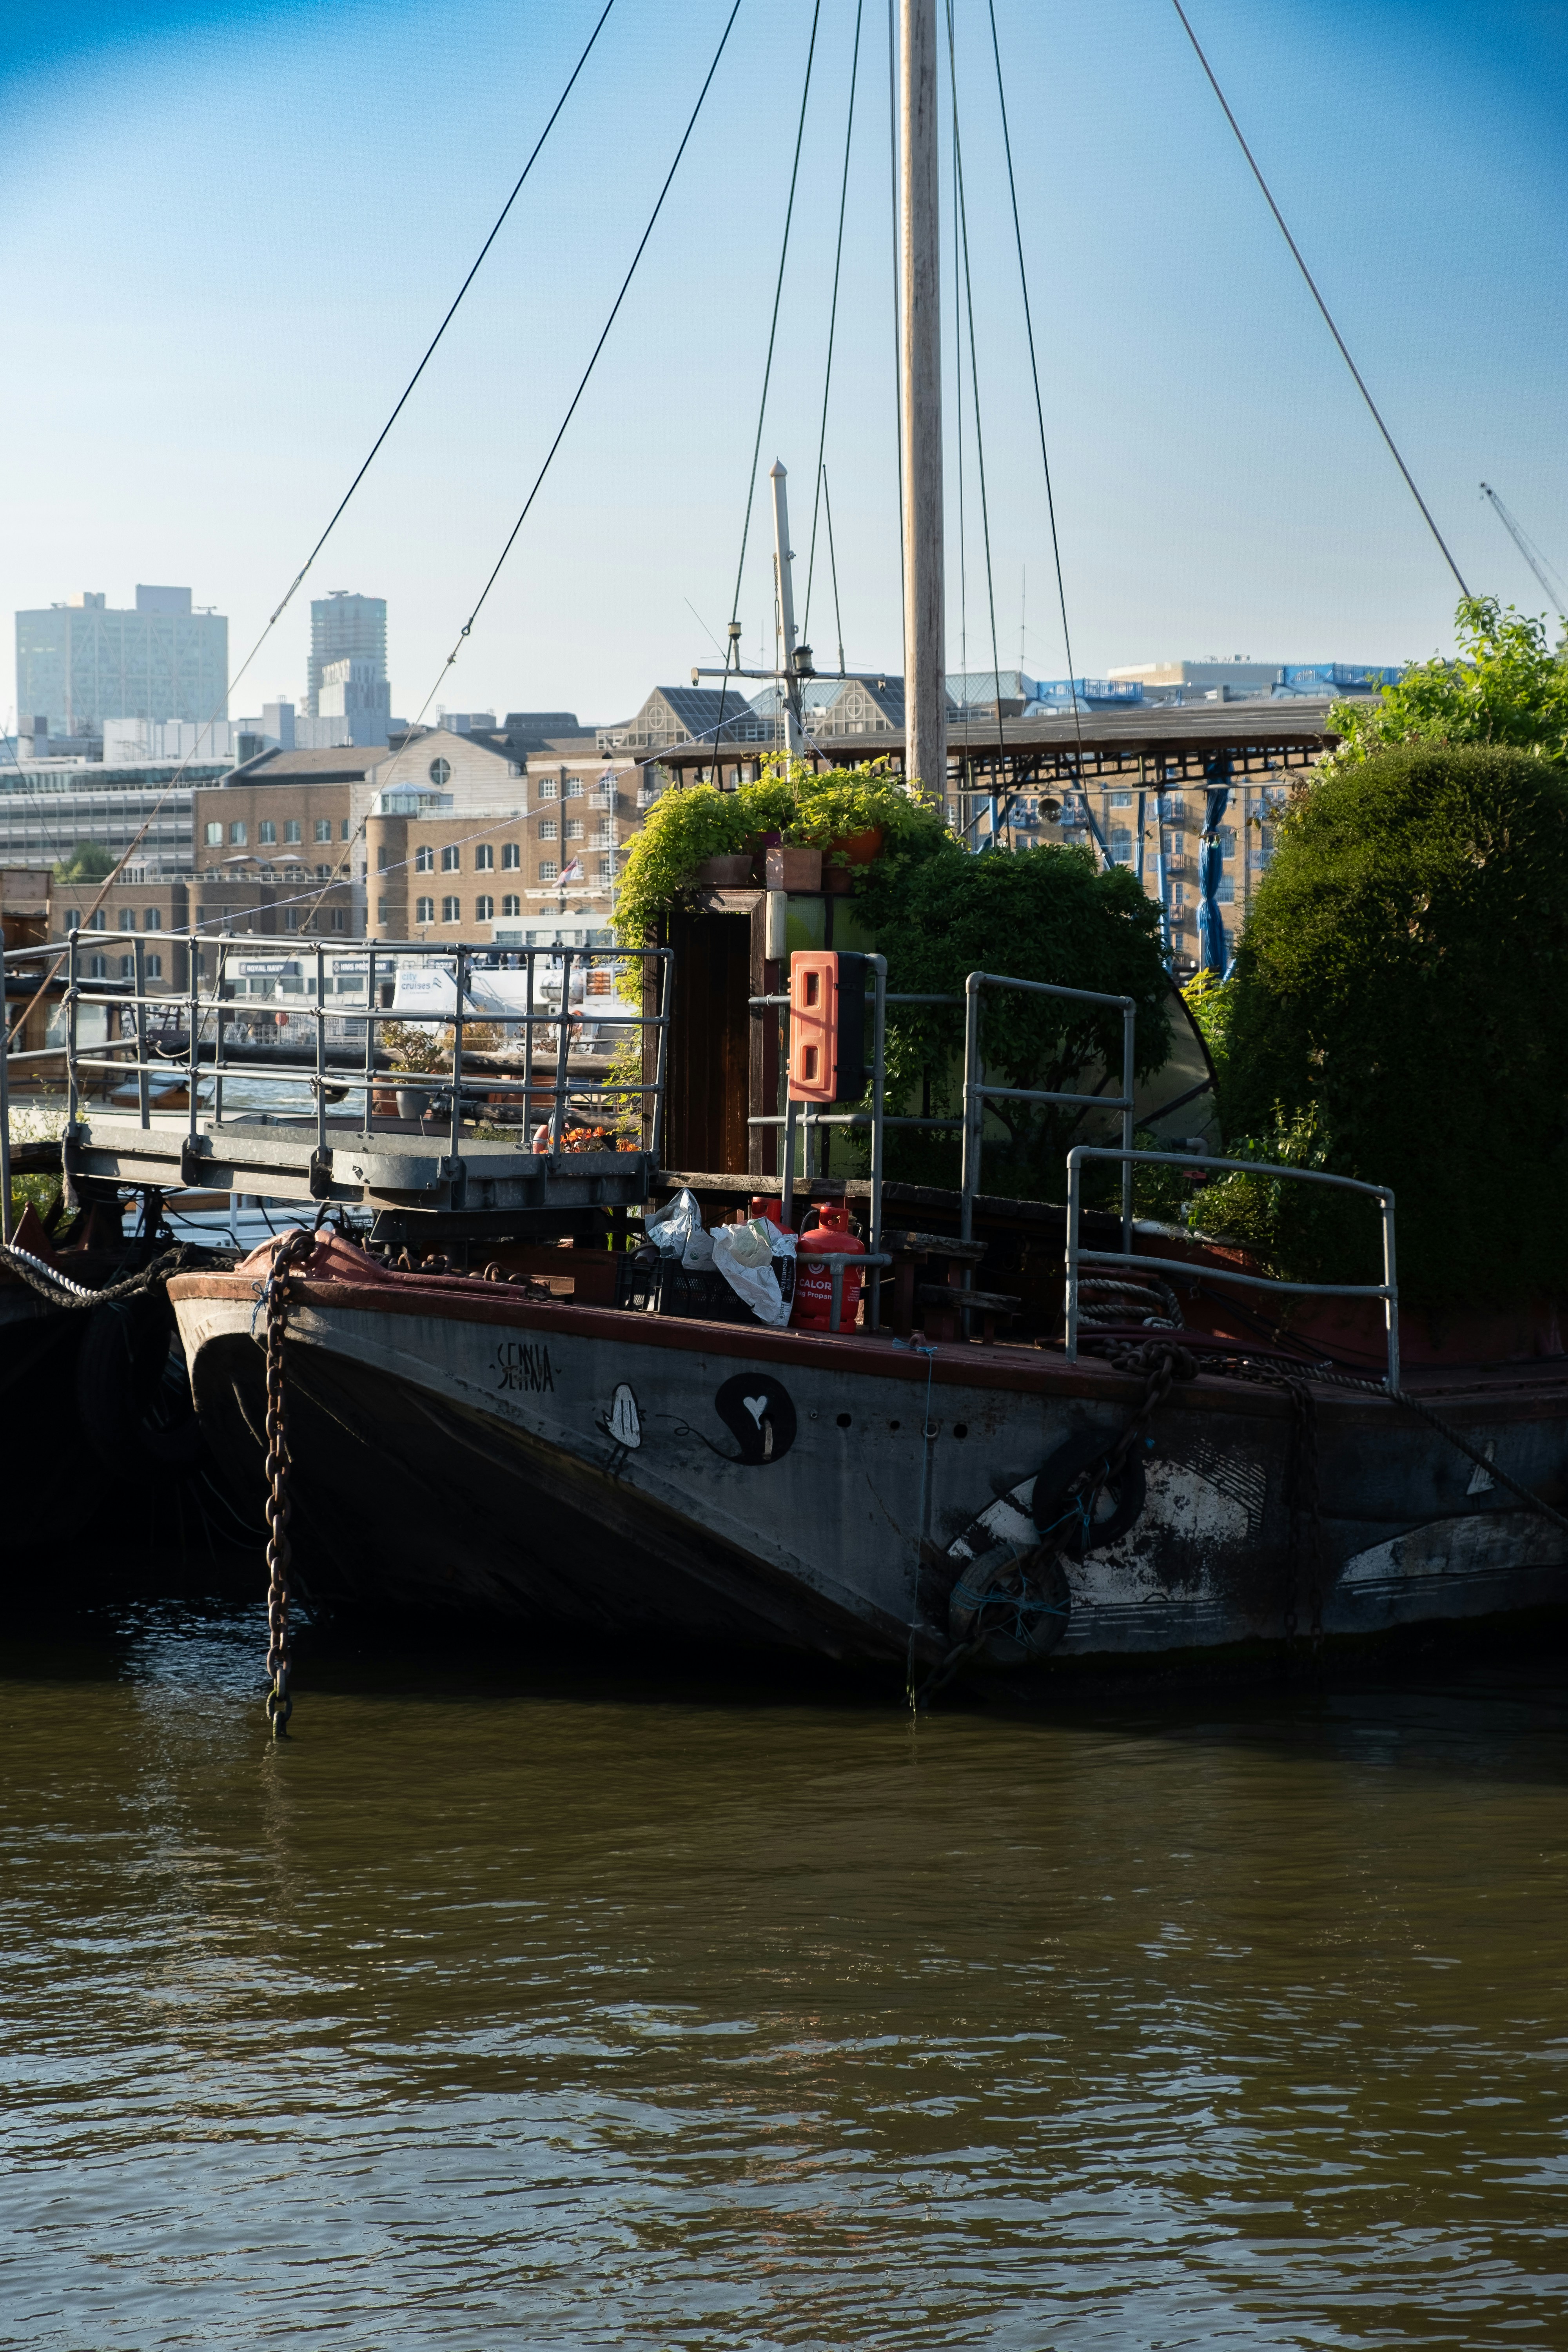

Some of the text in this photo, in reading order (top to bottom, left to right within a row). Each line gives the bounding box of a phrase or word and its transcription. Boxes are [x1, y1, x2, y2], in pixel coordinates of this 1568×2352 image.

[402, 972, 417, 982] city
[401, 981, 430, 989] cruises
[799, 1278, 832, 1290] CALOR
[807, 1291, 832, 1299] Propan
[497, 1343, 554, 1392] SENNA
